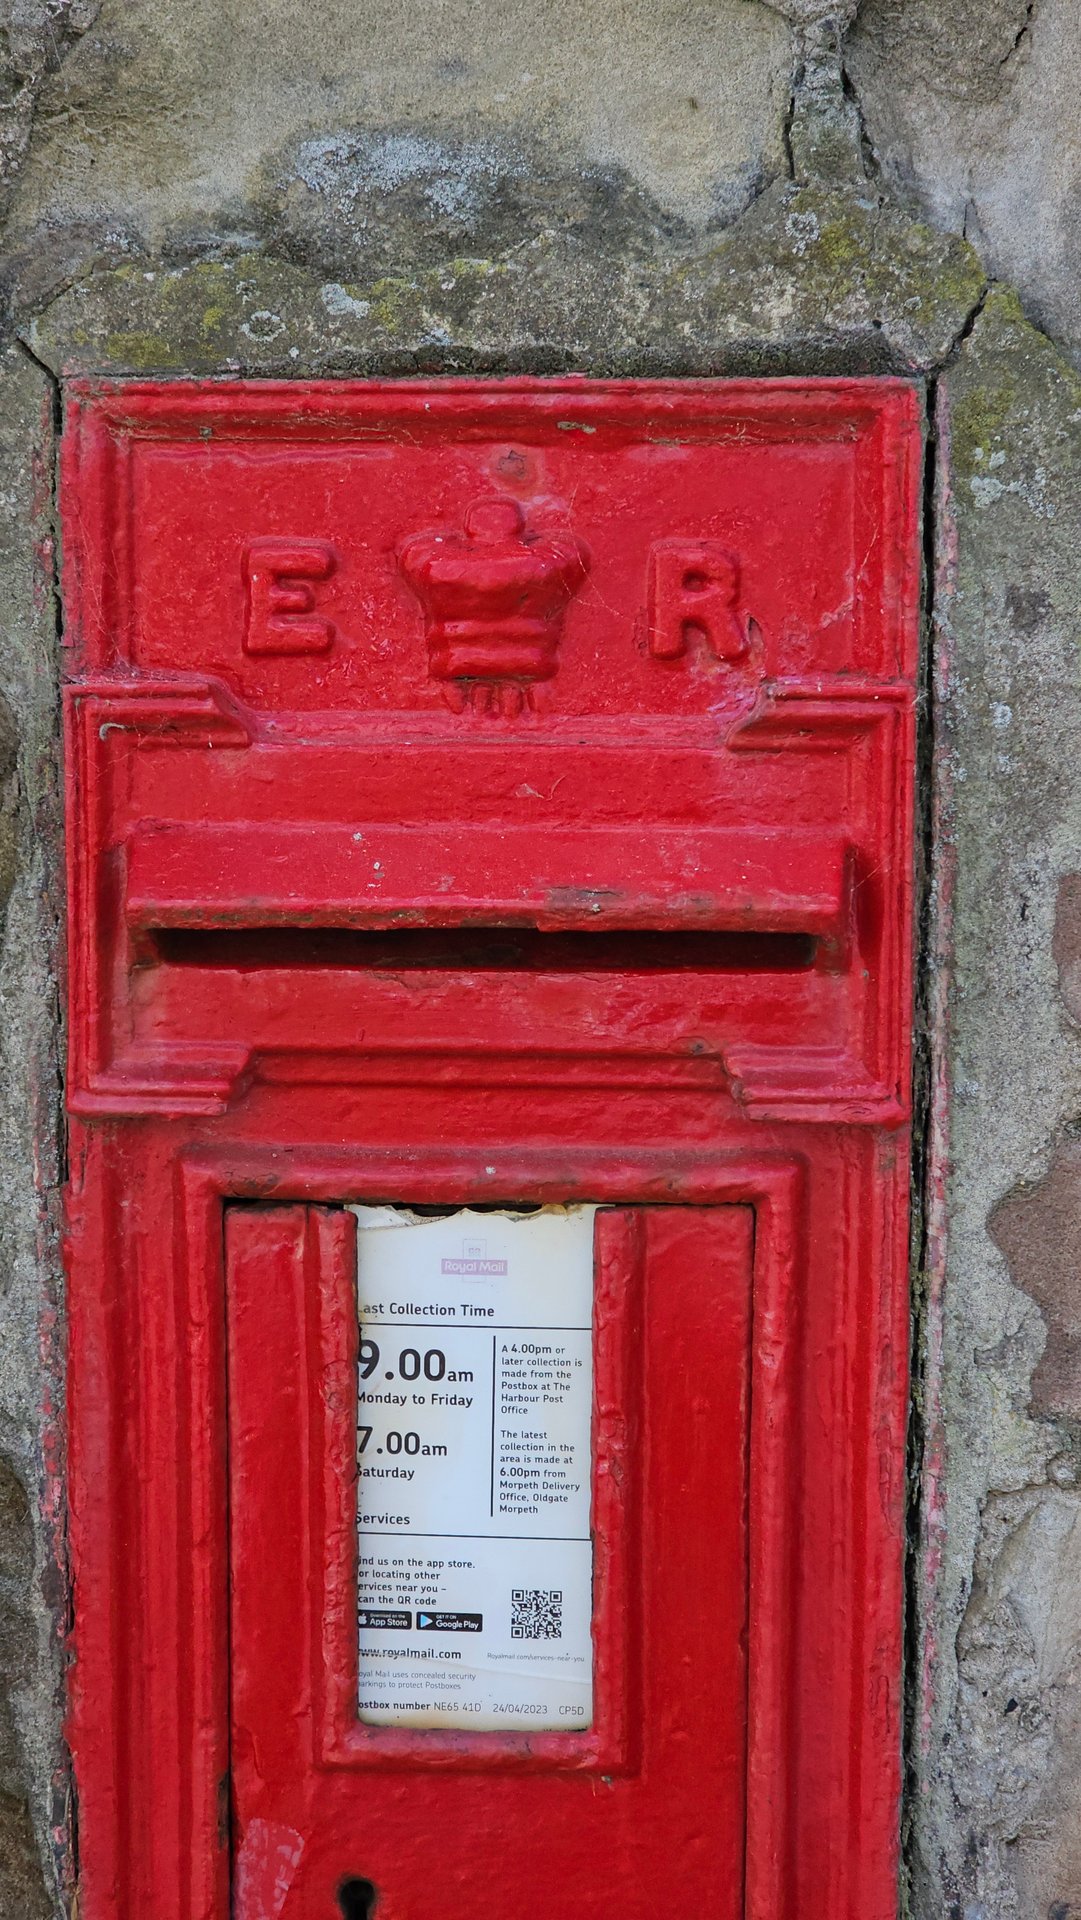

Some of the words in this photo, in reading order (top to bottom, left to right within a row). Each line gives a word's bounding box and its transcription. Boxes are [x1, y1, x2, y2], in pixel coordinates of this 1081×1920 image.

[243, 538, 337, 656] E
[646, 538, 749, 660] R
[445, 1261, 476, 1273] Royal
[480, 1261, 504, 1272] Mail
[359, 1303, 384, 1314] ast
[389, 1302, 456, 1316] Collection
[460, 1304, 495, 1317] Time
[501, 1345, 508, 1353] A
[511, 1343, 552, 1355] 4.00pm
[358, 1339, 474, 1382] 9.00am
[501, 1357, 523, 1366] later
[526, 1358, 571, 1367] collection
[574, 1358, 583, 1367] is
[501, 1370, 527, 1378] made
[530, 1370, 553, 1378] from
[556, 1371, 572, 1379] the
[501, 1381, 538, 1390] Postbox
[541, 1383, 551, 1391] at
[553, 1382, 571, 1391] The
[412, 1394, 425, 1405] to
[431, 1393, 473, 1408] Friday
[501, 1394, 540, 1403] Harbour
[543, 1395, 564, 1403] Post
[501, 1405, 528, 1414] Office
[500, 1430, 518, 1439] The
[521, 1430, 548, 1439] latest
[357, 1426, 448, 1457] 7.00am
[500, 1442, 544, 1451] collection
[547, 1443, 556, 1451] in
[559, 1444, 575, 1452] the
[523, 1454, 532, 1463] is
[534, 1456, 560, 1464] made
[563, 1456, 573, 1464] at
[500, 1467, 540, 1479] 6.00pm
[543, 1469, 566, 1478] from
[499, 1480, 539, 1490] Morpeth
[542, 1481, 580, 1492] Delivery
[499, 1492, 529, 1502] Office,
[532, 1493, 569, 1504] Oldgate
[499, 1505, 539, 1514] Morpeth
[358, 1556, 374, 1566] ind
[377, 1558, 389, 1566] us
[407, 1558, 423, 1567] the
[426, 1560, 445, 1569] app
[447, 1559, 476, 1569] store.
[358, 1570, 369, 1578] or
[372, 1570, 411, 1580] locating
[414, 1571, 441, 1580] other
[358, 1582, 392, 1591] ervices
[395, 1584, 418, 1592] near
[420, 1585, 438, 1594] you
[358, 1596, 375, 1604] can
[378, 1595, 394, 1604] the
[397, 1595, 411, 1605] QR
[414, 1597, 437, 1605] code
[370, 1618, 386, 1627] App
[387, 1618, 408, 1627] Store
[435, 1619, 463, 1630] Google
[463, 1620, 479, 1631] Play
[358, 1670, 373, 1678] oyal
[448, 1673, 477, 1681] security
[358, 1681, 386, 1689] arkings
[358, 1700, 390, 1709] ostbox
[393, 1701, 431, 1710] number
[433, 1701, 459, 1711] NE65
[492, 1703, 548, 1714] 24/04/2023
[558, 1705, 585, 1716] CP5D
